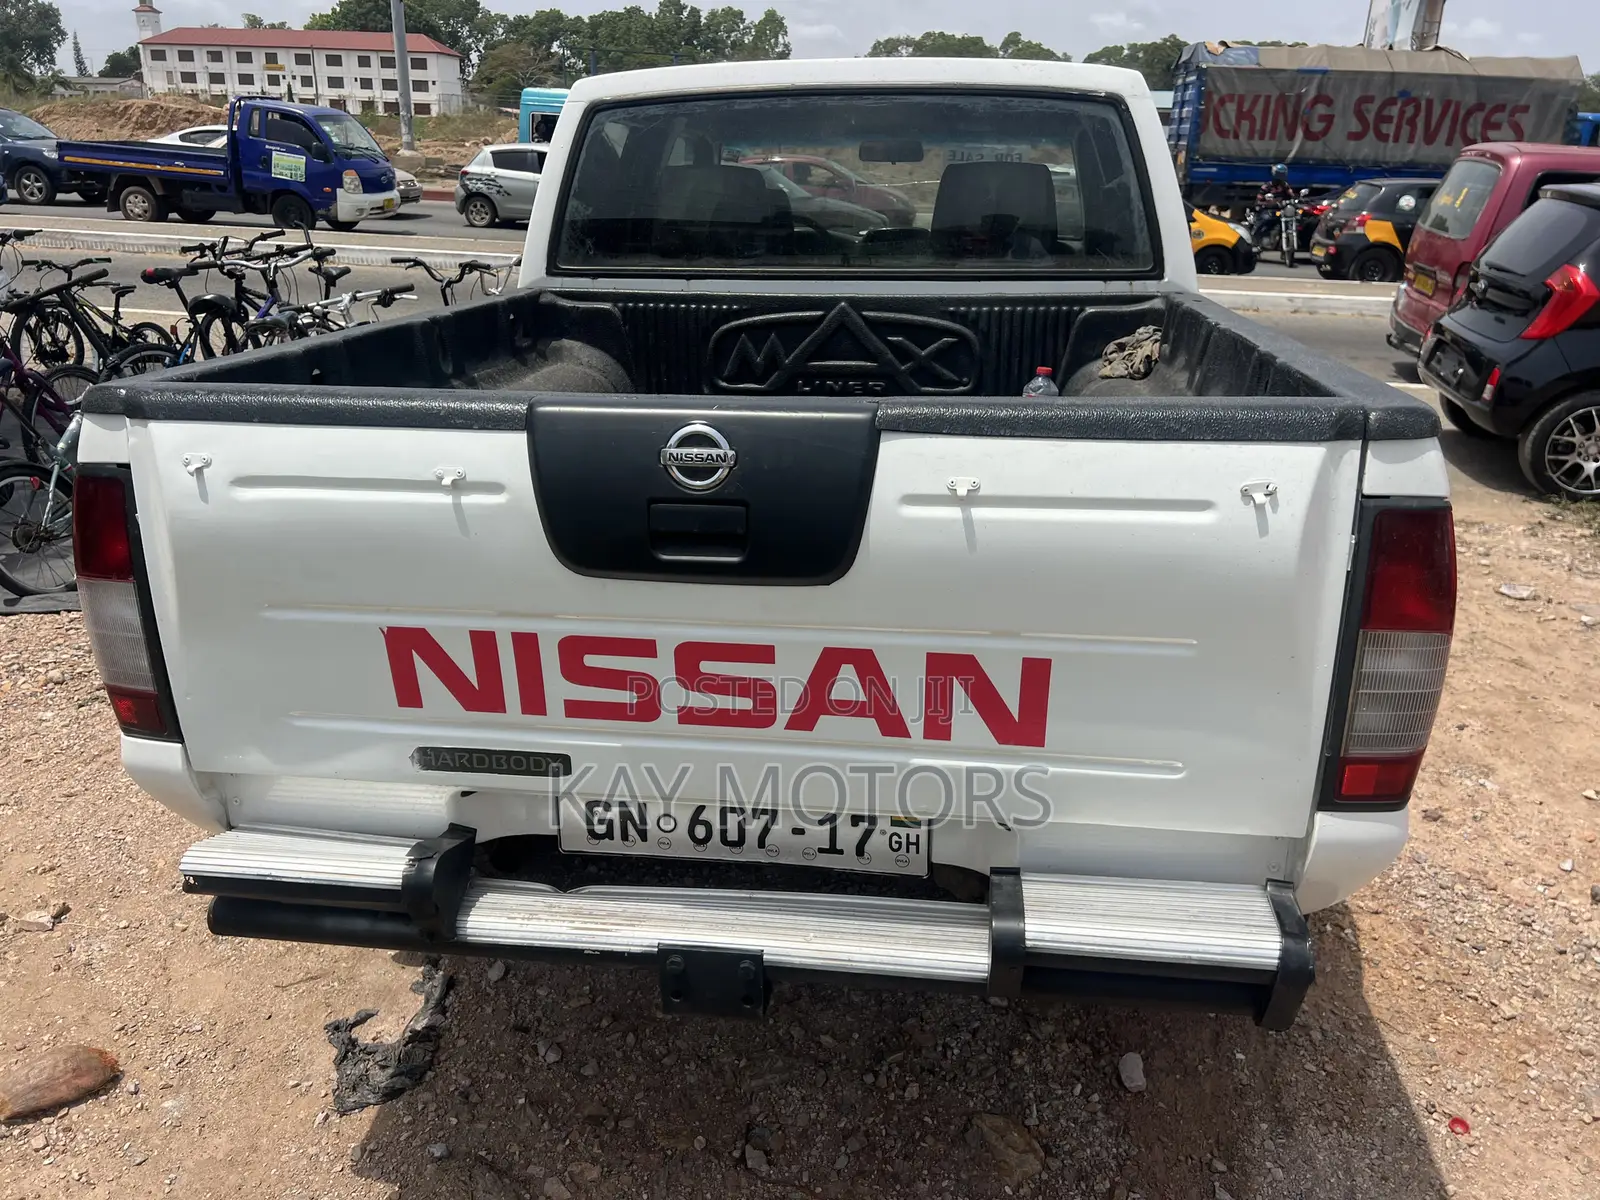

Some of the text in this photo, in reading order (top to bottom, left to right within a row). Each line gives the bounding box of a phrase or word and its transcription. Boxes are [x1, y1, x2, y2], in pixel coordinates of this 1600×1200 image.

[1348, 96, 1530, 147] SERVICES
[722, 302, 959, 390] MAX
[667, 452, 727, 463] NISSAN
[380, 626, 1053, 747] NISSAN
[420, 749, 562, 772] HARDBODY
[585, 800, 648, 842] GN
[888, 832, 920, 854] GH
